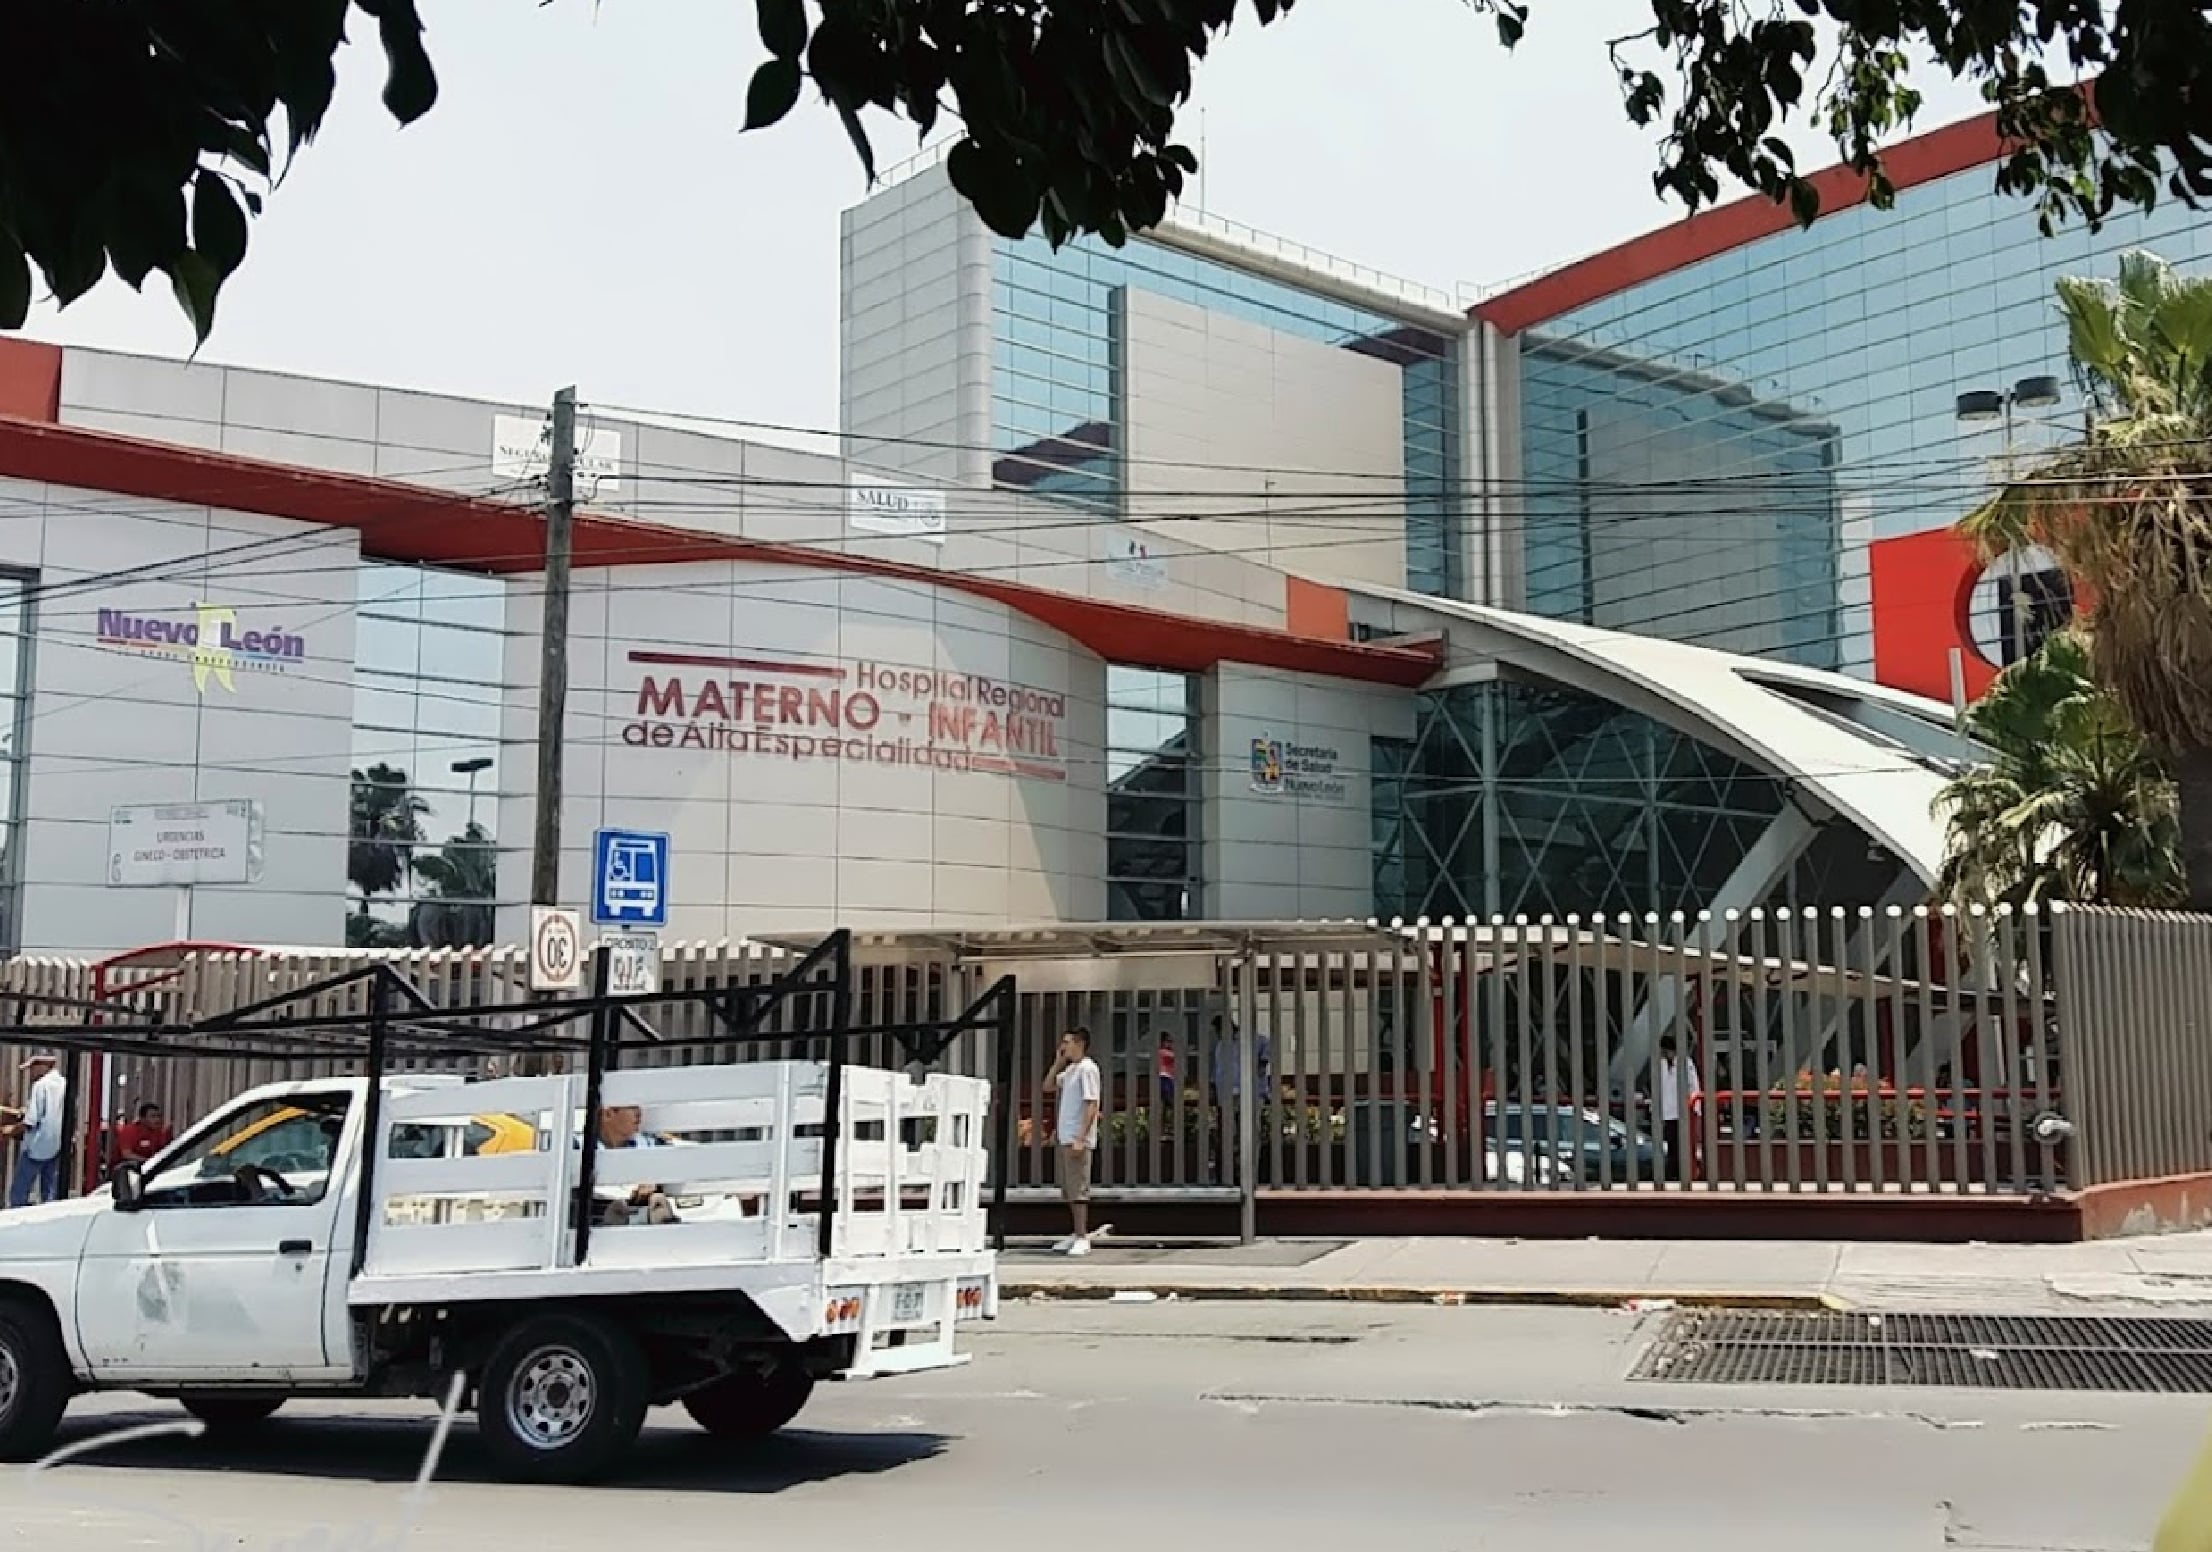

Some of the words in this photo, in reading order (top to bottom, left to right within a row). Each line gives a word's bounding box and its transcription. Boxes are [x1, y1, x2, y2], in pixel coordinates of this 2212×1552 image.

[856, 488, 909, 511] SALUD
[97, 607, 199, 646] Nuevo
[220, 622, 304, 657] León
[856, 660, 972, 701] Hospital
[977, 675, 1066, 719] Regional
[636, 676, 880, 732] MATERNO
[928, 701, 1058, 756] INFANTIL
[622, 722, 674, 748] de
[755, 724, 970, 772] Especialidad
